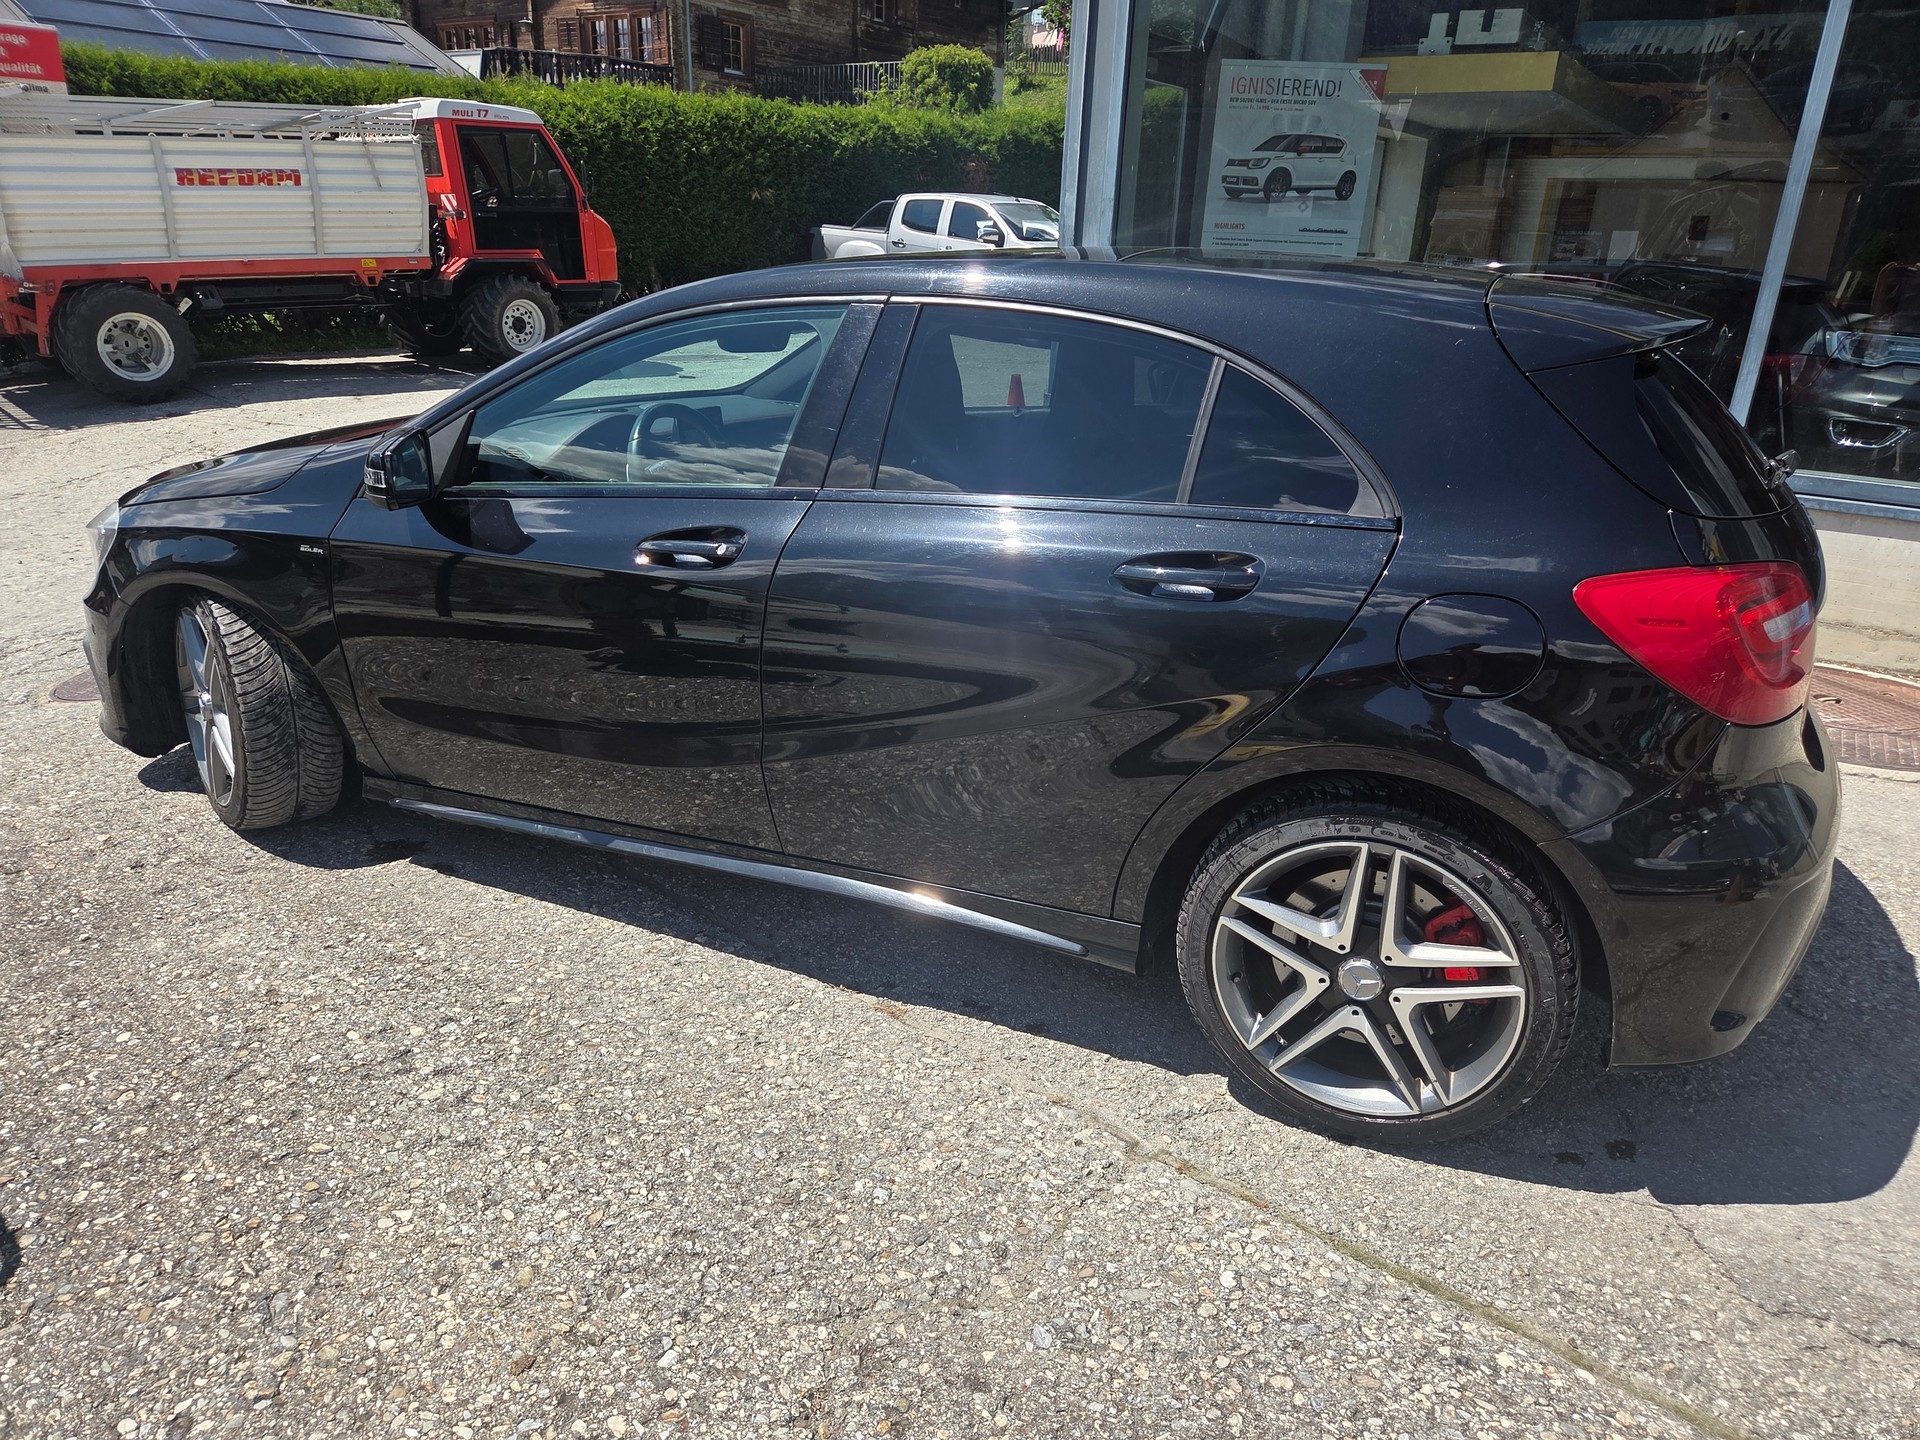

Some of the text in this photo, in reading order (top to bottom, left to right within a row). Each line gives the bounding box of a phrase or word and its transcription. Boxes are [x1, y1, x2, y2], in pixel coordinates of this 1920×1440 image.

[1230, 76, 1342, 98] IGNISIEREND!
[452, 109, 473, 117] MULI
[477, 108, 489, 118] T7
[1214, 222, 1246, 230] HIGHLIGHTS
